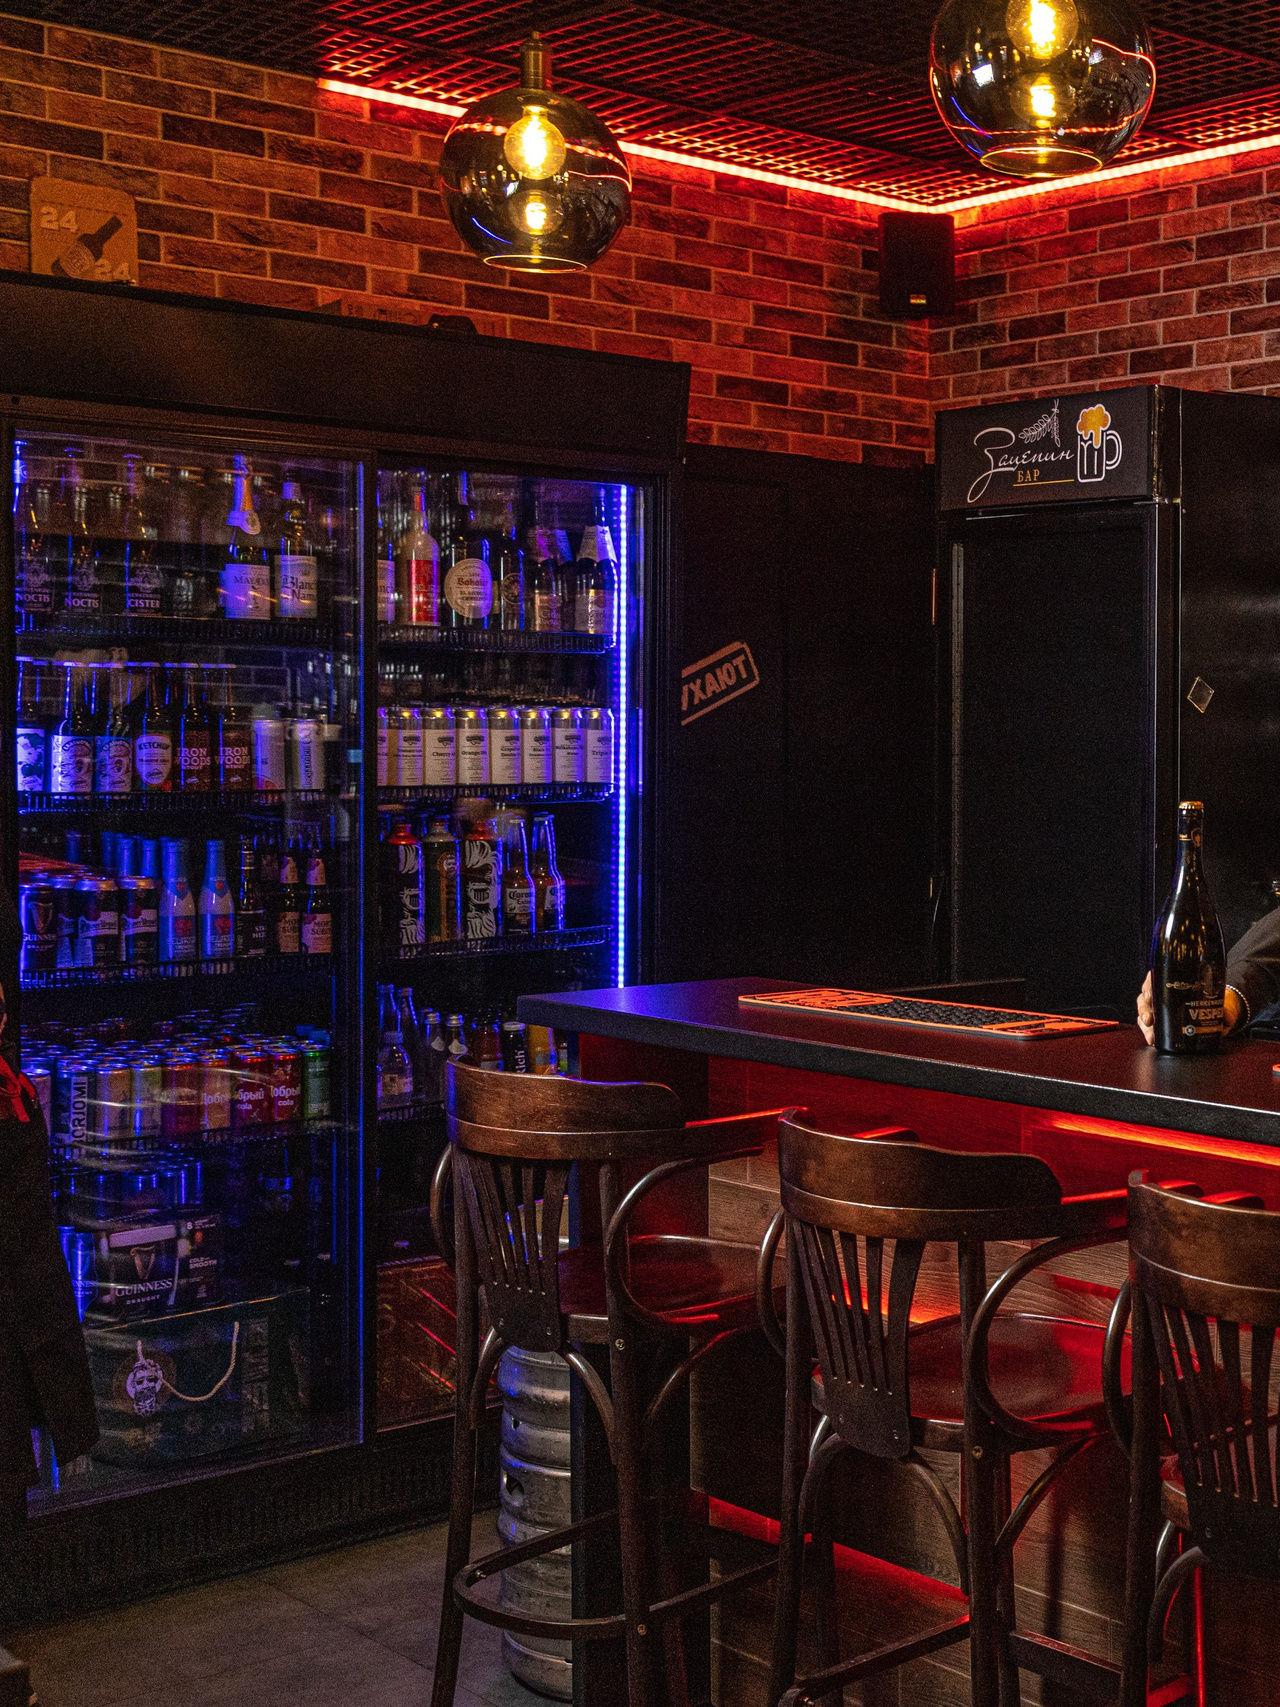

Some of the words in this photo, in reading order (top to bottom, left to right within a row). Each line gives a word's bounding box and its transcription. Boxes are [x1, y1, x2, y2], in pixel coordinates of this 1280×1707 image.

[40, 204, 79, 235] 24
[1017, 469, 1041, 484] БАР
[65, 597, 100, 608] NOCTIS
[138, 741, 170, 751] KETCHUP
[217, 745, 249, 757] IRON
[178, 747, 208, 757] IRON
[189, 1259, 218, 1270] SMOOTH
[114, 1278, 174, 1297] GUINNESS
